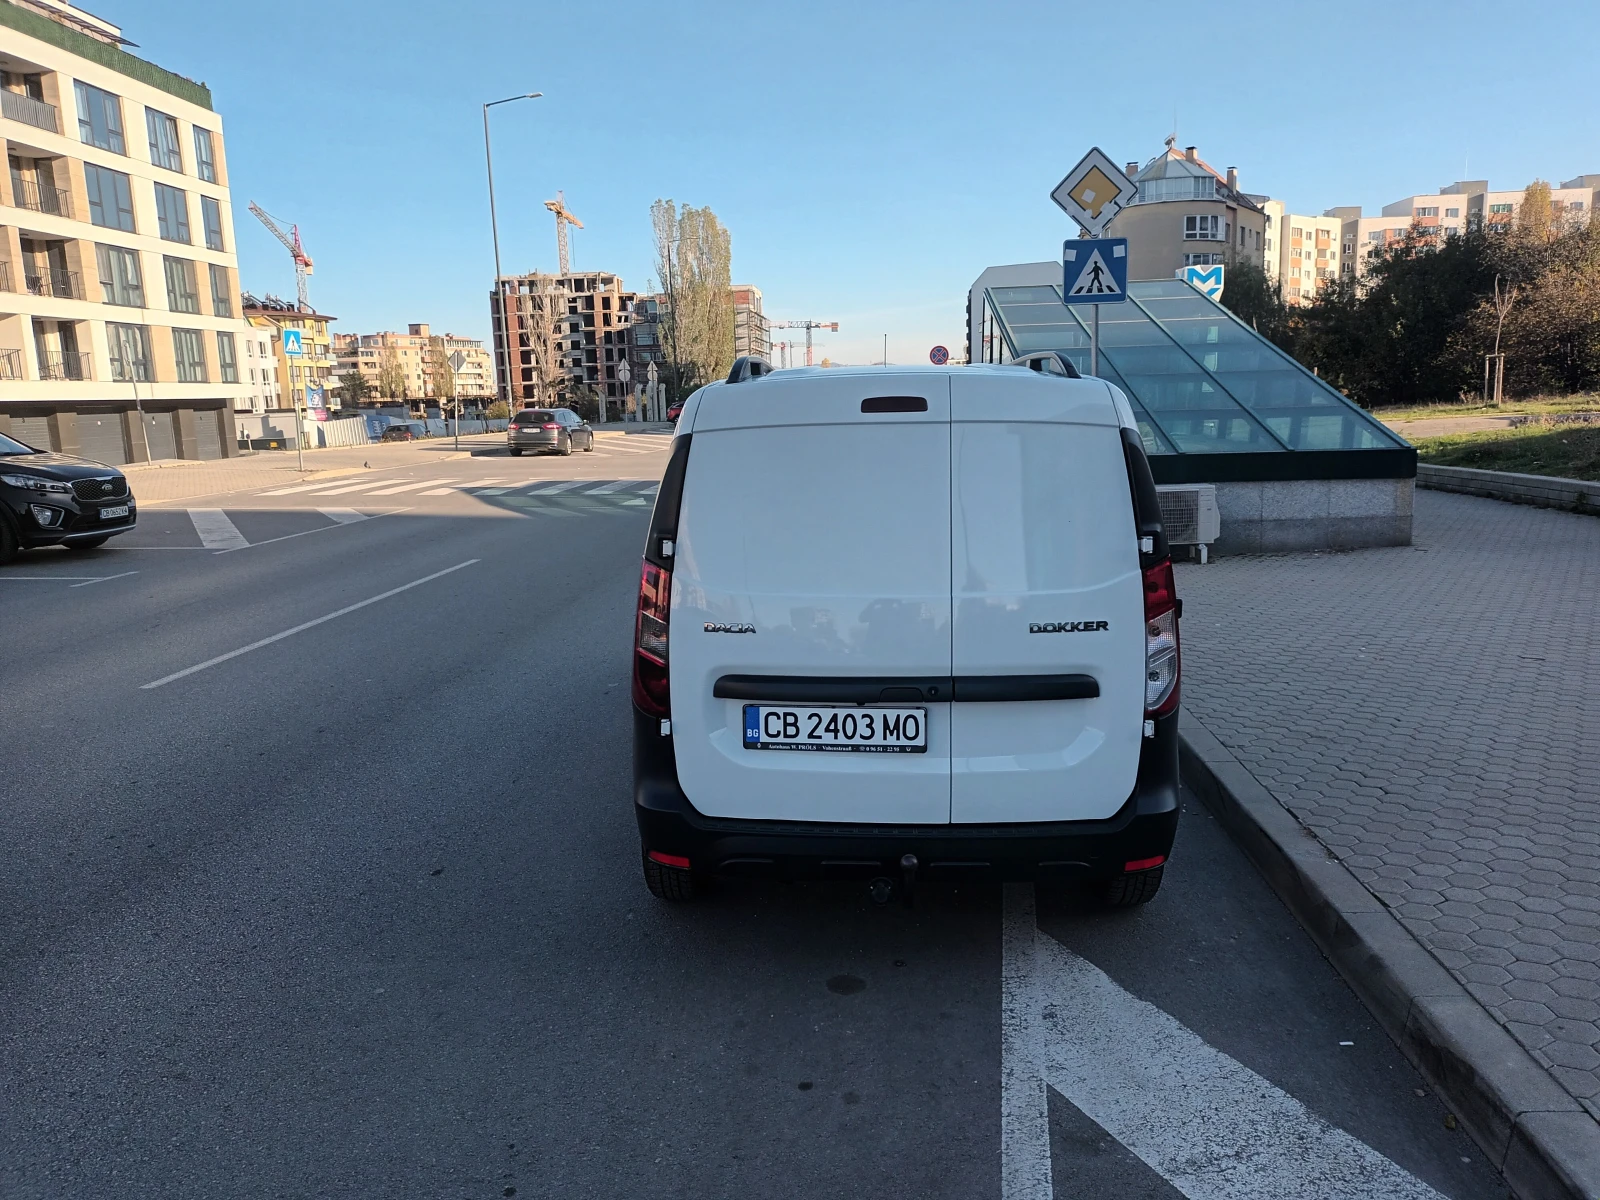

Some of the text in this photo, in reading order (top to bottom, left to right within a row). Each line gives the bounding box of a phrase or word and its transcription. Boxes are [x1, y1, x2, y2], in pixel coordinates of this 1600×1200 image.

[704, 621, 756, 633] DACIA
[1029, 621, 1109, 633] DOKKER
[764, 711, 920, 741] CB 2403 MO
[746, 729, 759, 738] BG
